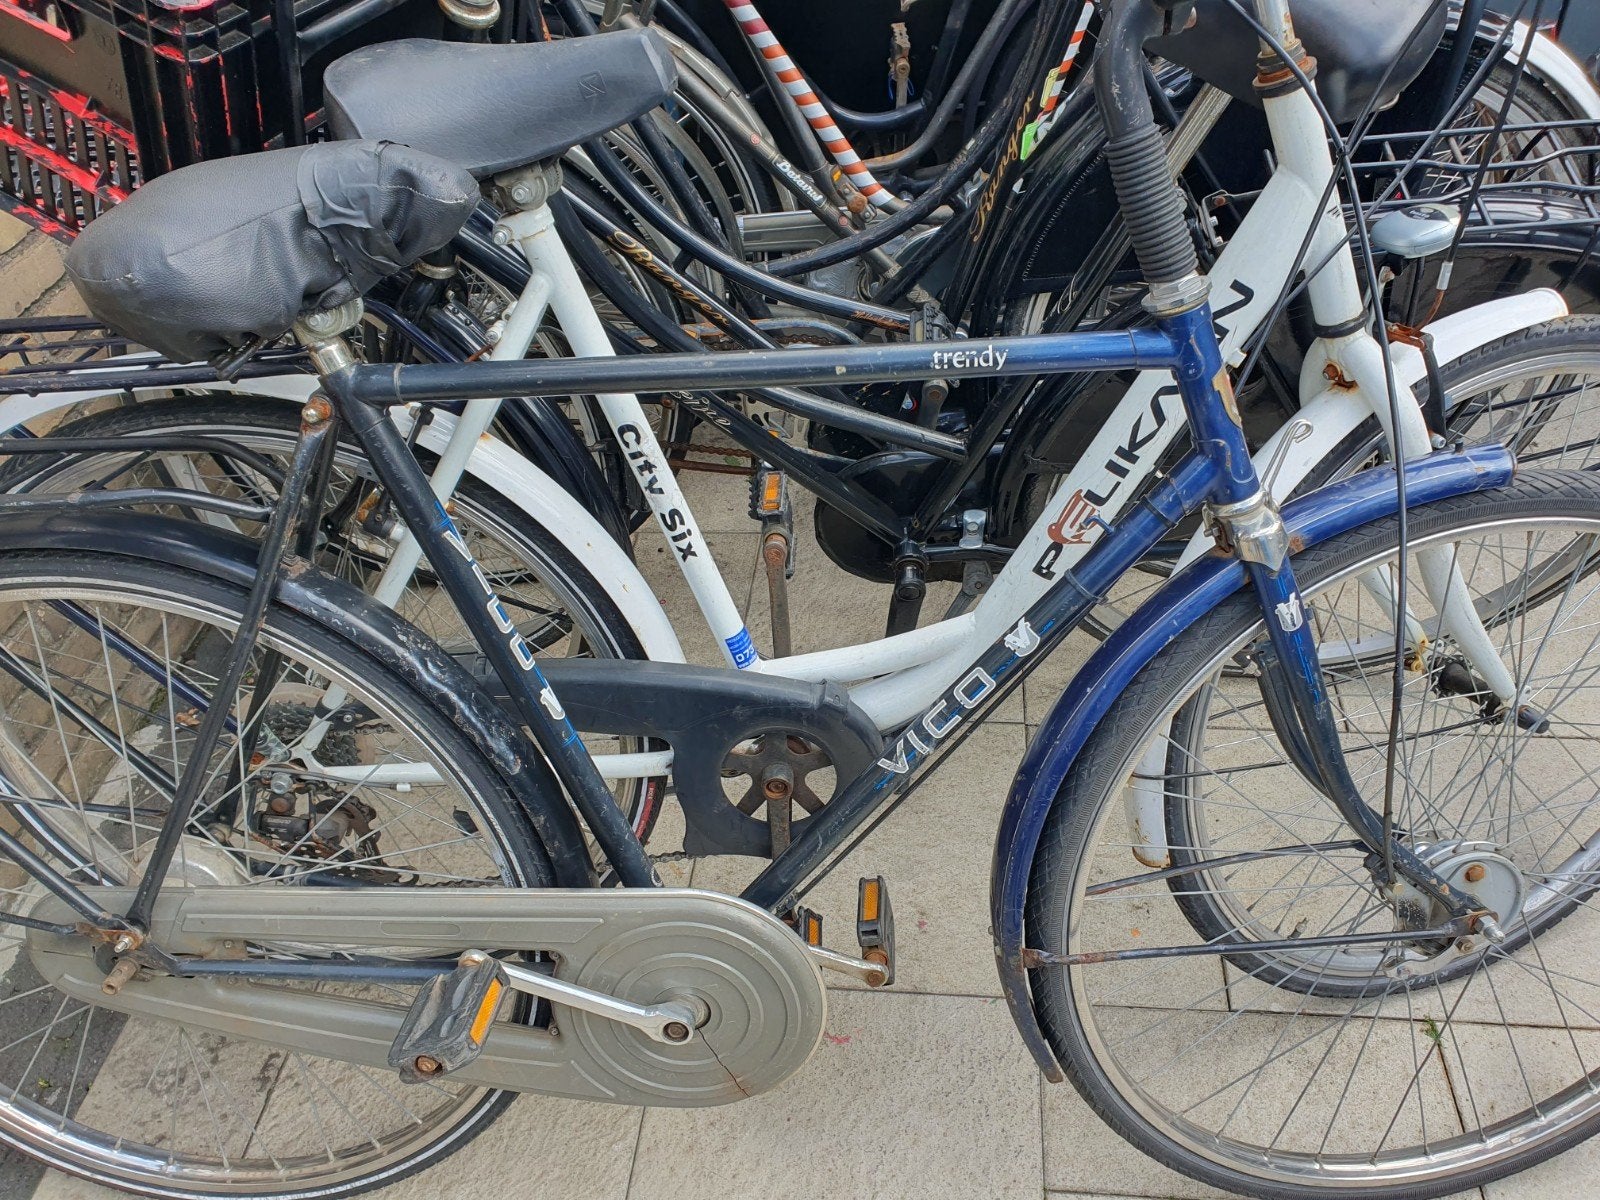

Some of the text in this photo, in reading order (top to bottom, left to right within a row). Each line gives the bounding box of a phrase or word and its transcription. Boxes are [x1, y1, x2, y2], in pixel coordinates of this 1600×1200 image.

[776, 159, 823, 201] Batavus
[969, 90, 1035, 242] Ranger
[932, 345, 1009, 371] trendy
[616, 423, 698, 563] City Six
[877, 667, 997, 774] VICO
